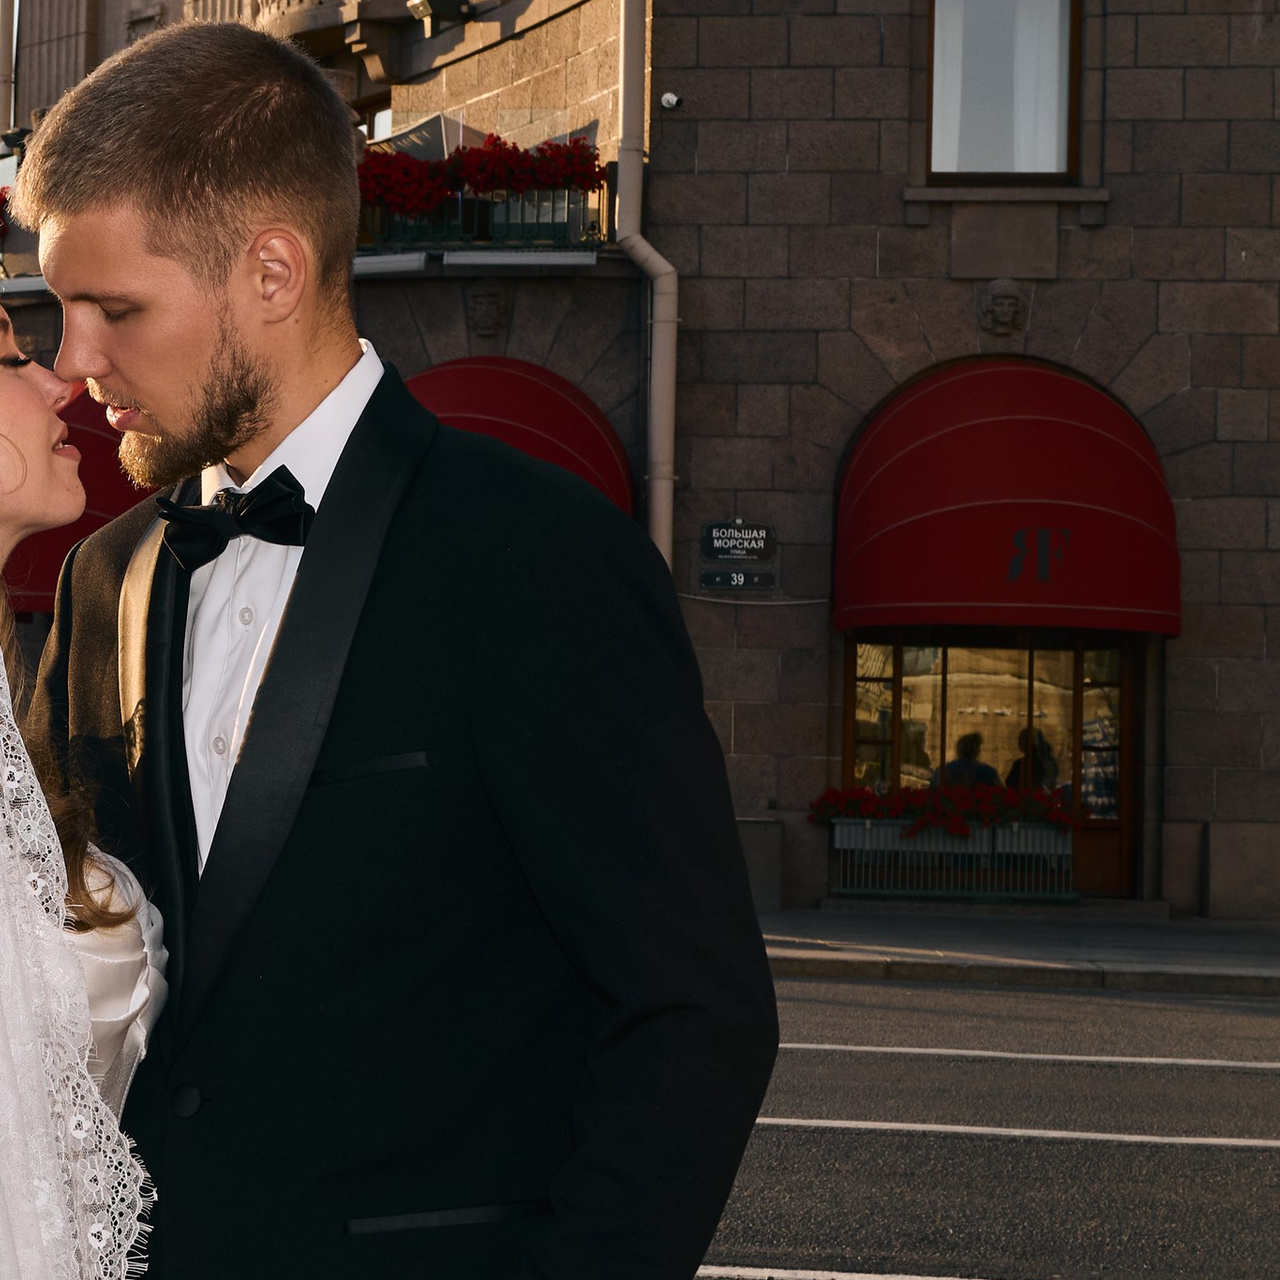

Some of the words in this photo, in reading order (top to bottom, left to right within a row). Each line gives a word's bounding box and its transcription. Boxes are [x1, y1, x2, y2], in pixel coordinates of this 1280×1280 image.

[712, 528, 766, 539] БОЛЬШАЯ
[713, 539, 764, 549] МОРСКАЯ
[731, 573, 744, 585] 39
